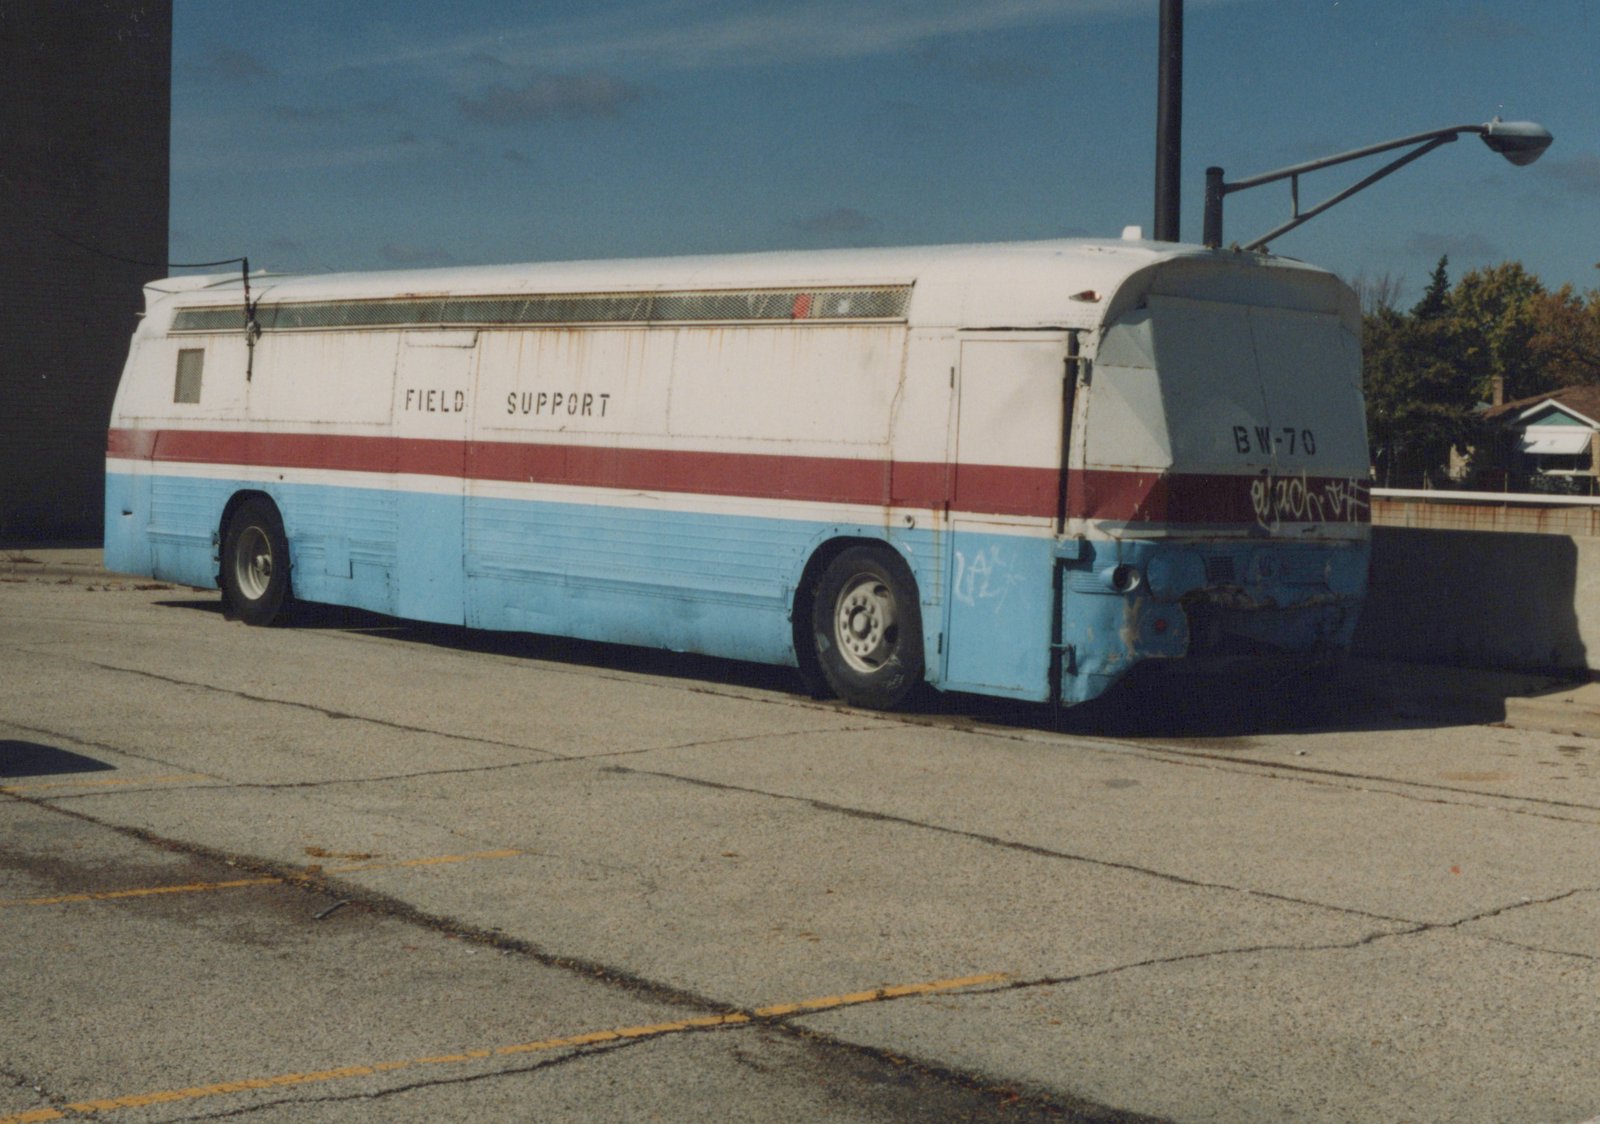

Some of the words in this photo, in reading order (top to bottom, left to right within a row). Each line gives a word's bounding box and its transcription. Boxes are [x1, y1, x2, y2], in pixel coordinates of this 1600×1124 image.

[404, 389, 465, 413] FIELD
[507, 391, 611, 418] SUPPORT
[1232, 425, 1317, 456] BW-70
